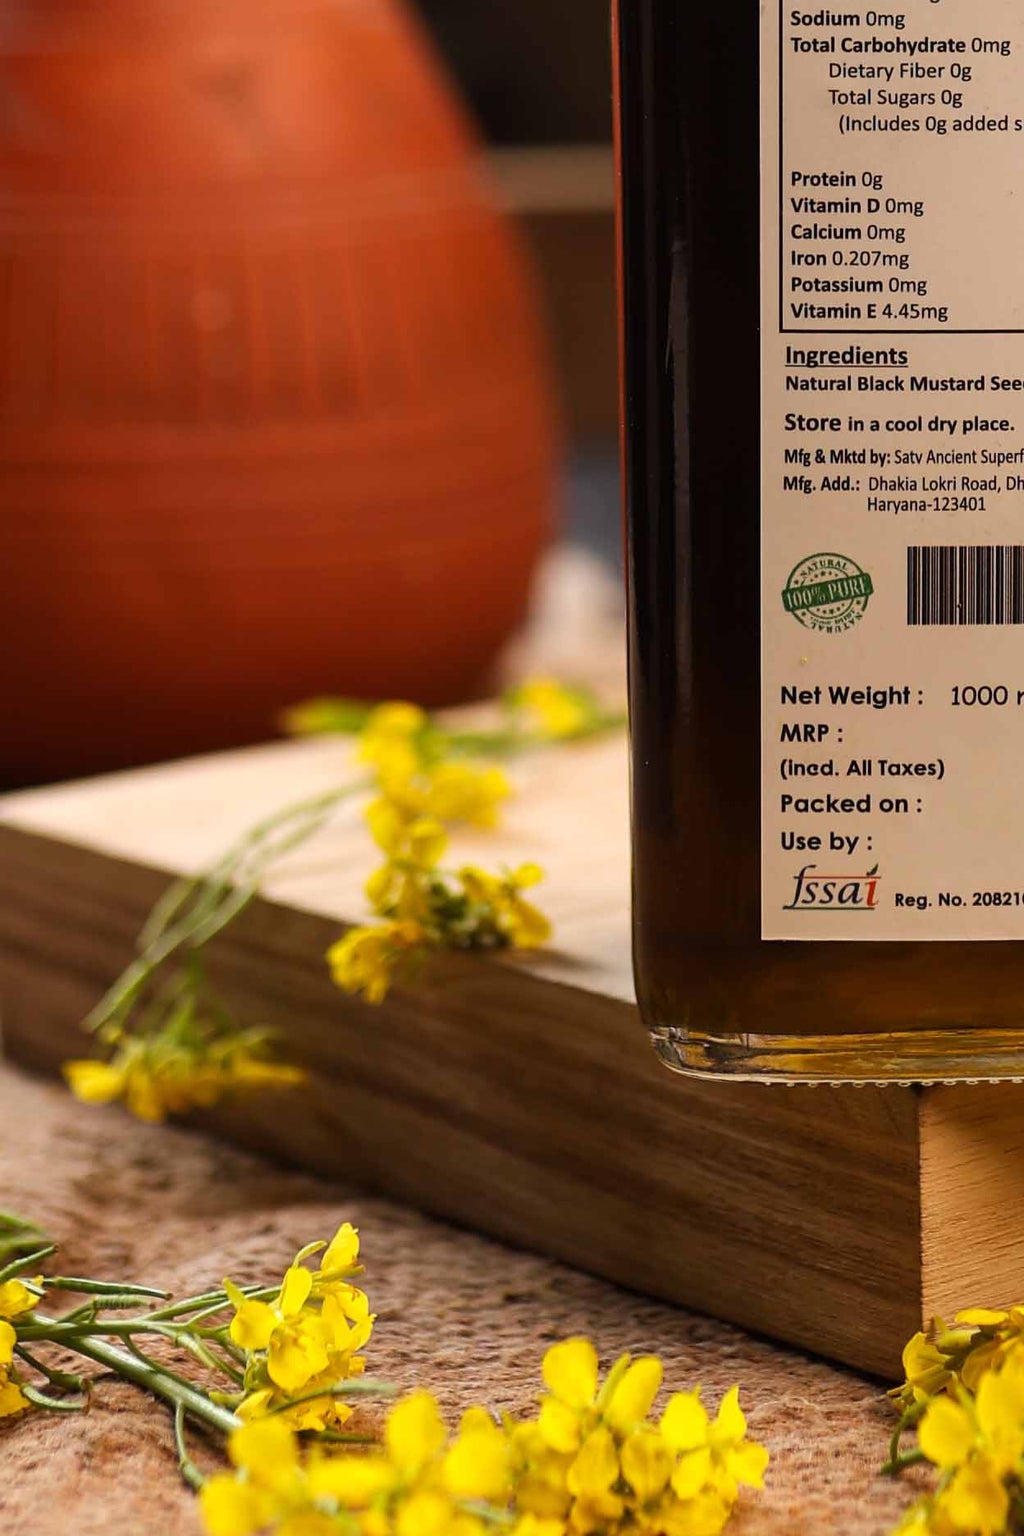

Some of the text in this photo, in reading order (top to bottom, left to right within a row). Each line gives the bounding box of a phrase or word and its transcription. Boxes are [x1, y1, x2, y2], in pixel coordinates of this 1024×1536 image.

[789, 9, 906, 31] Sodium 0mg
[789, 35, 1011, 57] Total Carbohydrate 0mg
[828, 61, 972, 83] Dietary Fiber 0g
[827, 87, 964, 109] Total Sugars 0g
[838, 113, 921, 136] (Includes
[925, 115, 948, 136] 0g
[952, 114, 1009, 132] added
[790, 170, 884, 191] Protein 0g
[789, 196, 924, 218] Vitamin D 0mg
[790, 222, 906, 244] Calcium 0mg
[790, 249, 910, 271] Iron 0.207mg
[791, 276, 928, 297] Potassium 0mg
[789, 301, 949, 323] Vitamin E 4.45mg
[784, 345, 909, 368] Ingredients
[785, 374, 852, 392] Natural
[857, 374, 905, 392] Black
[909, 374, 986, 392] Mustard
[783, 412, 1015, 436] Store in a cool dry place.
[783, 447, 812, 468] Mfg
[814, 448, 827, 465] &
[829, 447, 867, 465] Mktd
[869, 448, 891, 469] by:
[893, 448, 924, 465] Satv
[925, 448, 978, 465] Ancient
[782, 474, 817, 495] Mfg.
[868, 474, 918, 492] Dhakia
[921, 474, 957, 492] Lokri
[961, 474, 1002, 494] Road,
[867, 496, 987, 516] Haryana-123401
[800, 559, 849, 579] NATURAL
[786, 575, 869, 609] 100% PURE
[780, 685, 823, 706] Net
[827, 685, 911, 710] Weight
[951, 685, 1009, 707] 1000
[779, 723, 830, 743] MRP
[846, 758, 873, 777] All
[877, 758, 945, 781] Taxes)
[780, 793, 872, 814] Packed
[878, 798, 909, 814] on
[780, 831, 822, 851] Use
[829, 830, 860, 856] by
[782, 863, 882, 912] fssai
[894, 892, 933, 911] Reg.
[938, 892, 968, 907] No.
